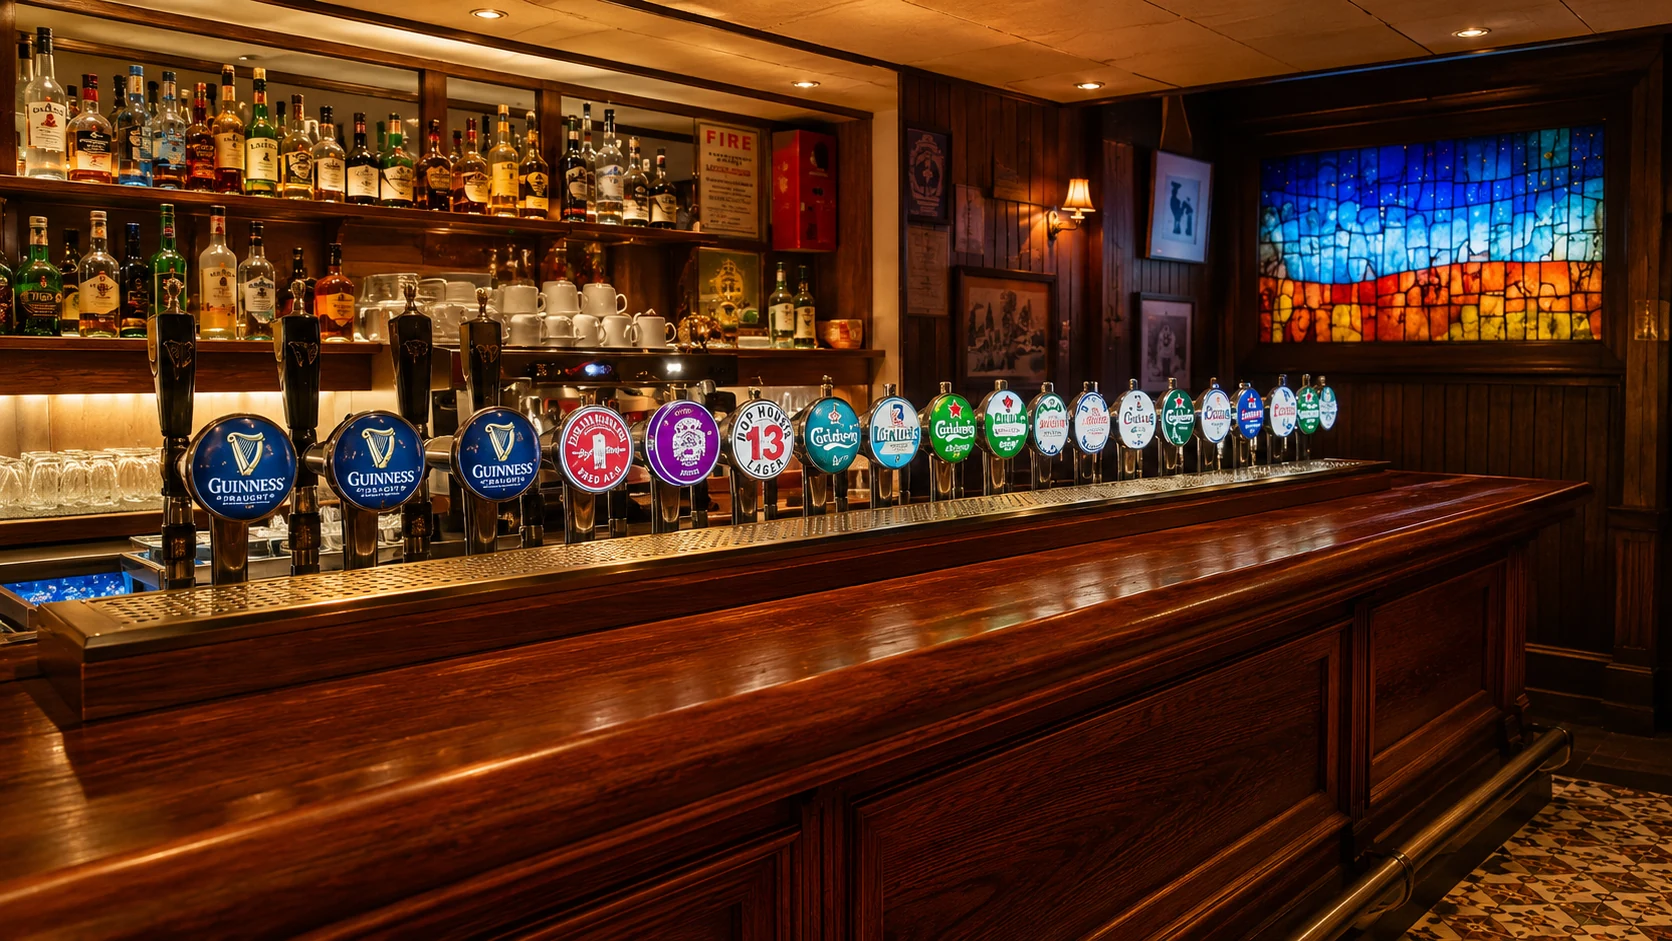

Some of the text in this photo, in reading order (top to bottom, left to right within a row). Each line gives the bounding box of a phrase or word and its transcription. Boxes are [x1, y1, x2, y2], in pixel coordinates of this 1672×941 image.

[706, 130, 752, 151] FIRE
[746, 424, 785, 461] 13
[472, 462, 533, 478] GUINNESS
[747, 459, 784, 475] LAGER
[208, 477, 285, 494] GUINNESS
[347, 470, 415, 486] GUINNESS
